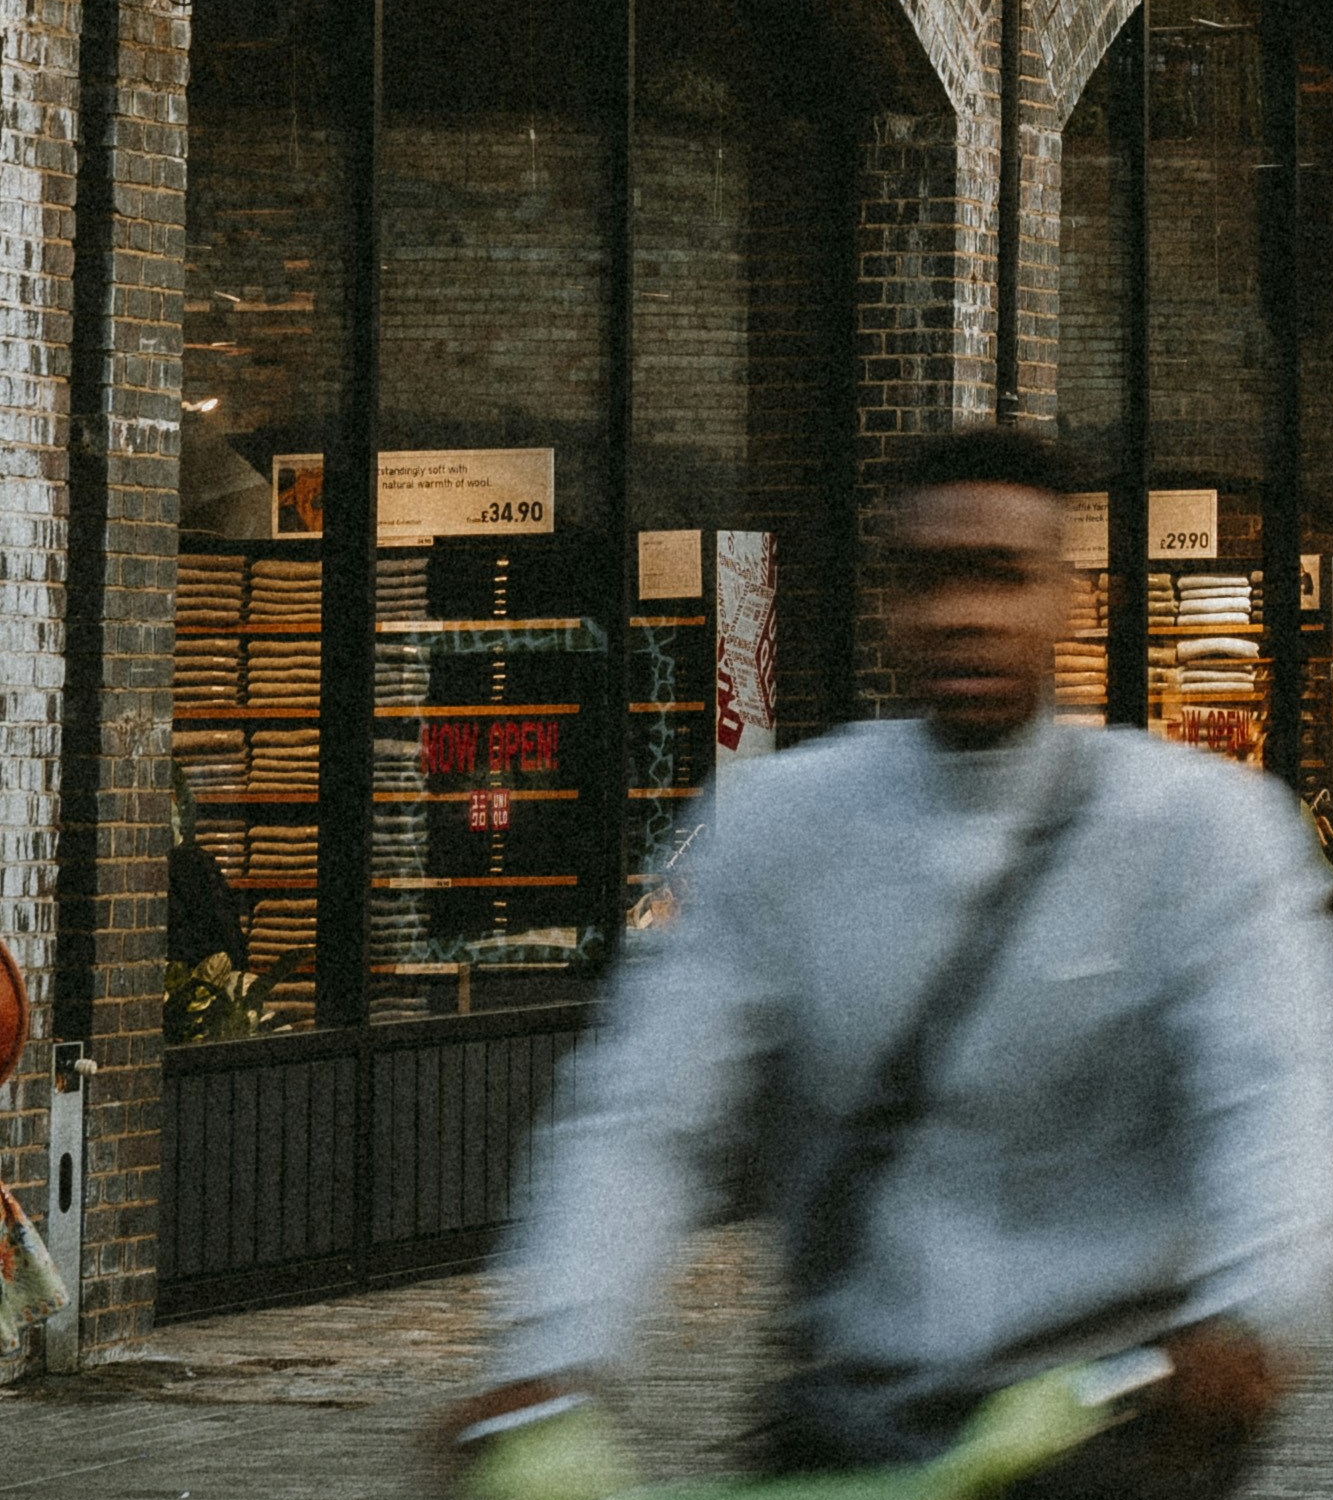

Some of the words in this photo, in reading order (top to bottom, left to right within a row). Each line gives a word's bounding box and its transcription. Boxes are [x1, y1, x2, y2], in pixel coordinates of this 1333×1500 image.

[428, 465, 445, 475] soft
[449, 464, 467, 474] with
[382, 480, 413, 489] natural
[418, 479, 453, 488] warmth
[455, 479, 465, 488] of
[481, 501, 542, 523] £34.90
[1160, 532, 1209, 549] £29.90
[421, 722, 477, 774] NOW
[489, 722, 558, 771] OPEN!
[494, 794, 507, 808] UNI
[494, 811, 508, 827] QLO
